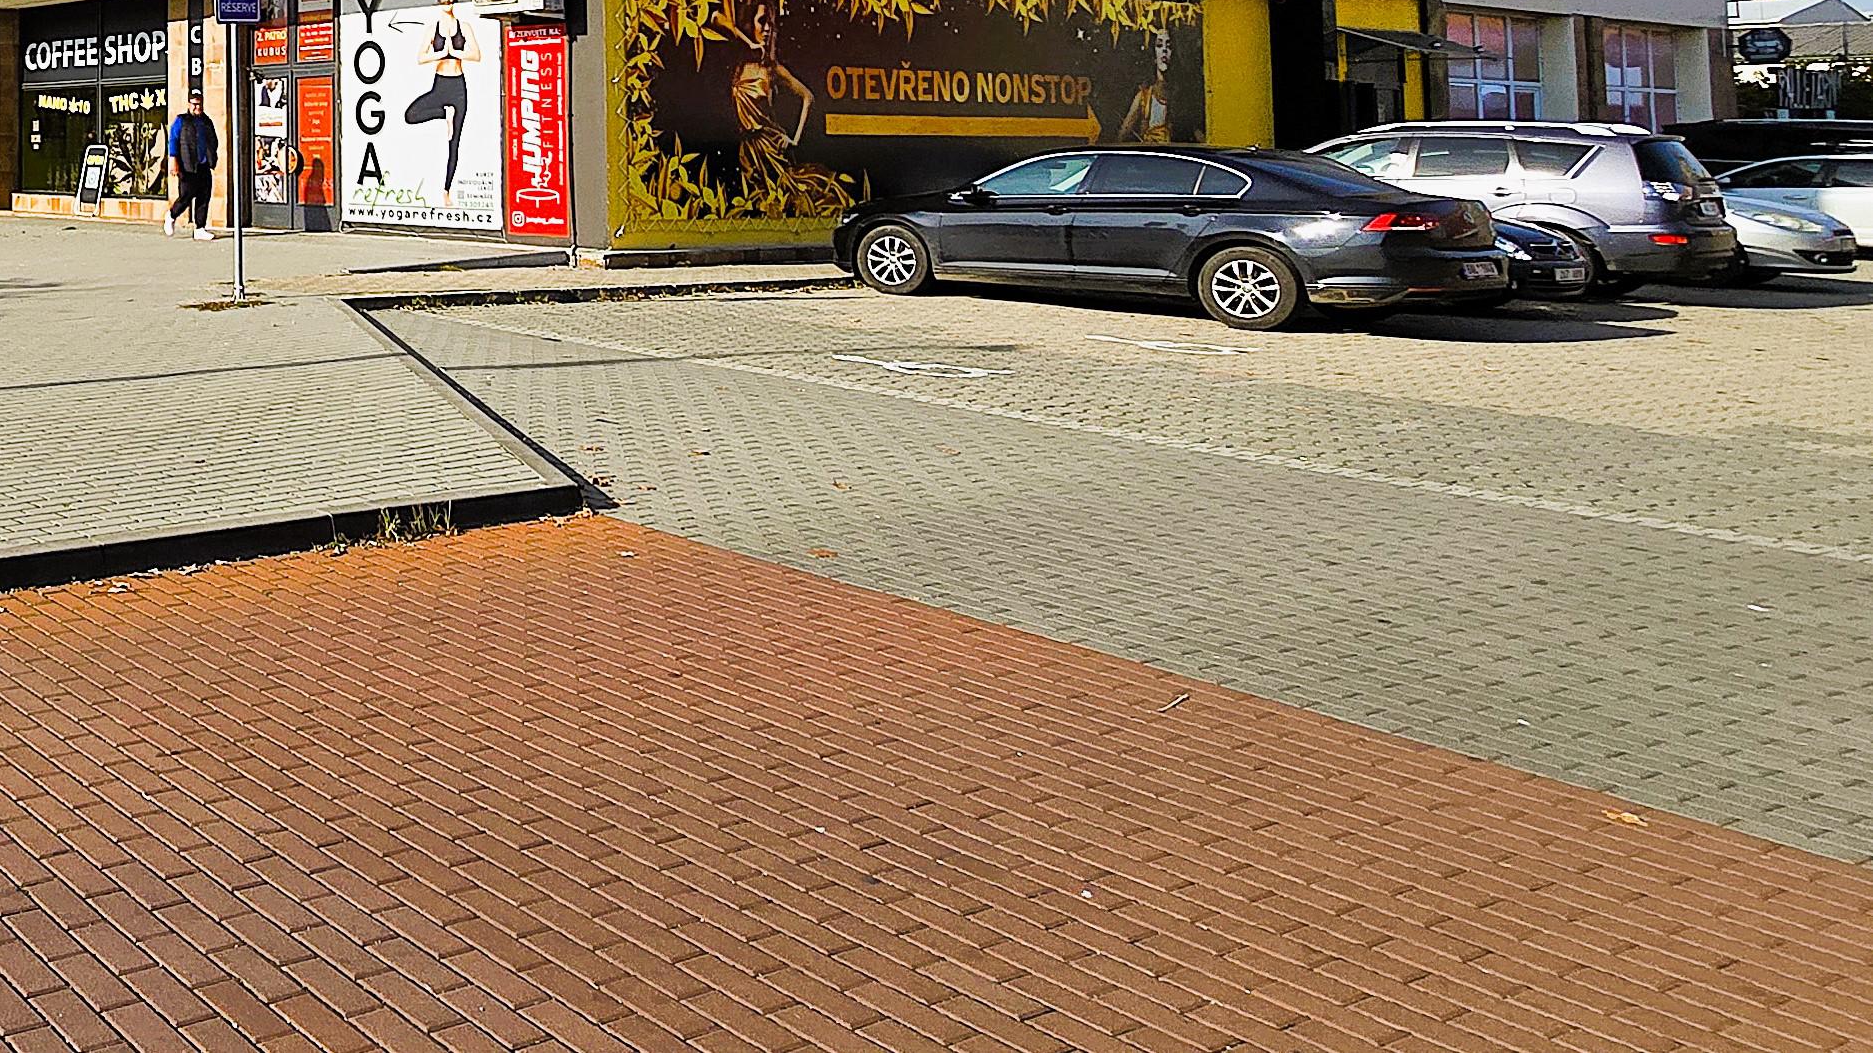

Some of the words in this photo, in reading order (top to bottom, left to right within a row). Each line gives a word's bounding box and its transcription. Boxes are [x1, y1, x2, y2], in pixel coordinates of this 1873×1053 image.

[25, 36, 99, 71] COFFEE
[104, 30, 166, 66] SHOP
[37, 94, 68, 111] NANO
[109, 91, 139, 113] THC
[540, 52, 553, 149] FITNESS
[827, 60, 970, 103] OTEVŘENO
[976, 72, 1092, 106] NONSTOP
[520, 49, 542, 176] JUMPING
[352, 171, 432, 210] refresh
[349, 208, 493, 224] www.yogarefresh.cz
